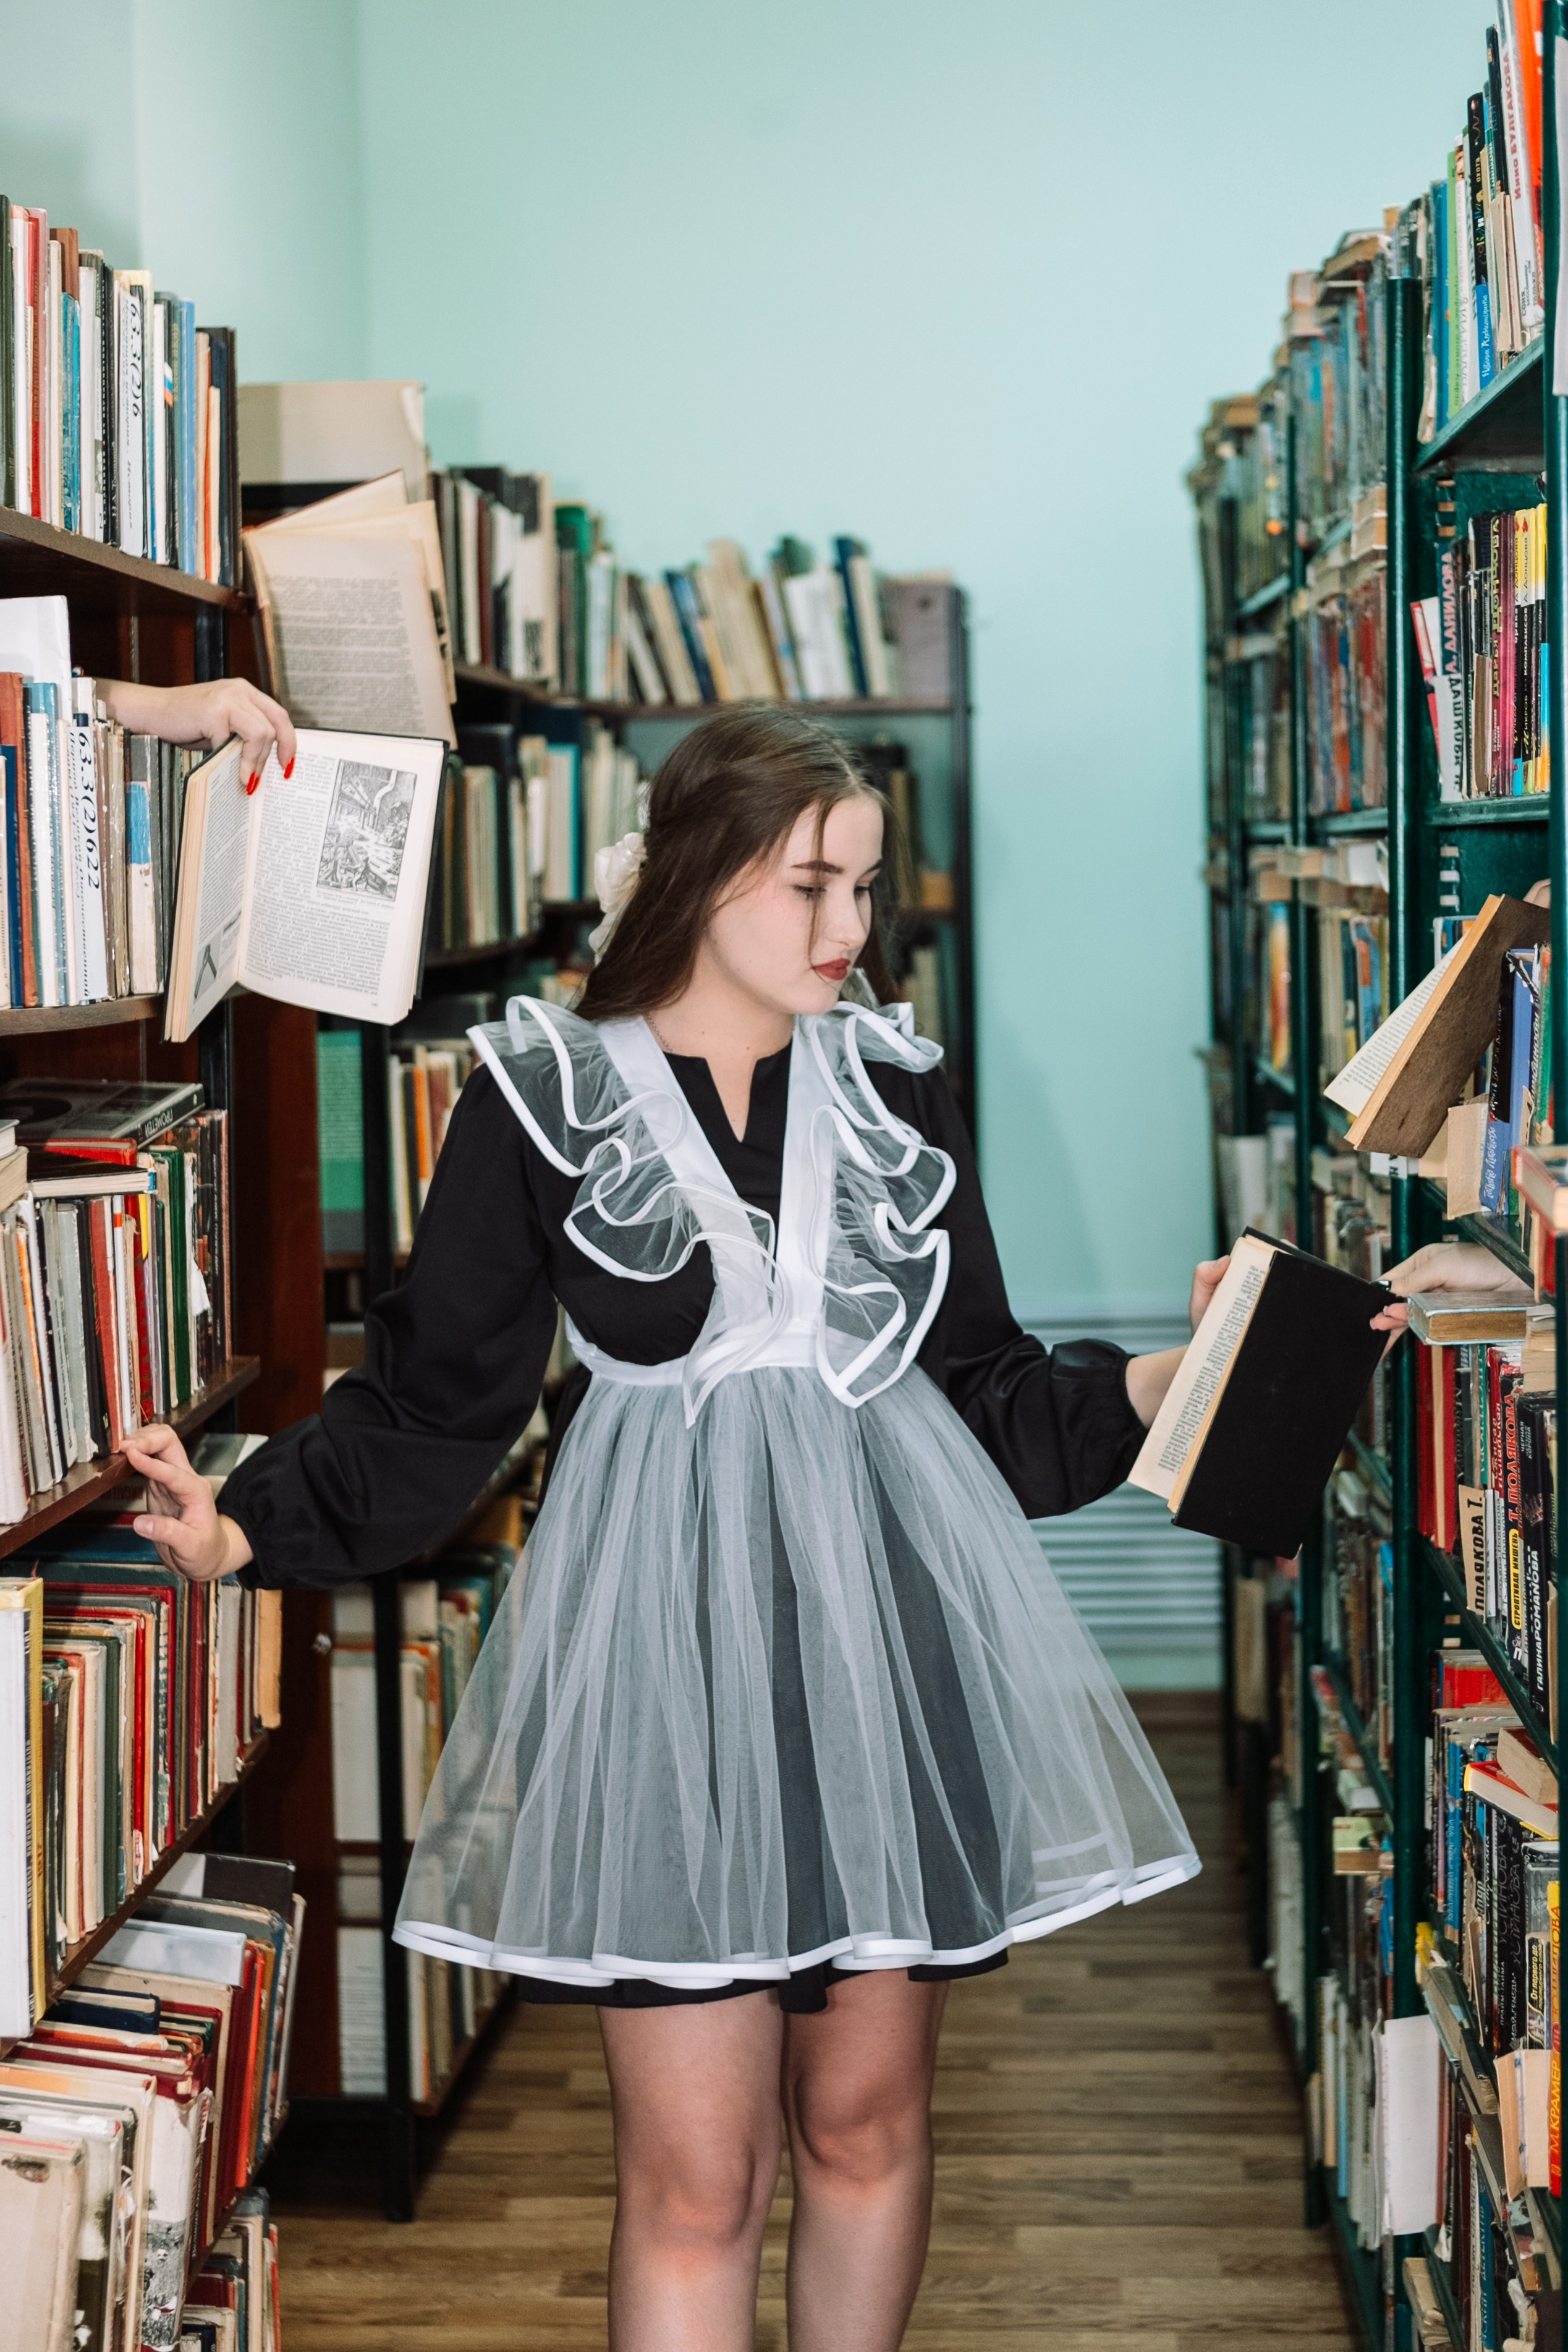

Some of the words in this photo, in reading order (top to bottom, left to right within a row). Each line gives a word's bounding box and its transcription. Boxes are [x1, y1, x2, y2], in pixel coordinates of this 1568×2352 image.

[1502, 52, 1517, 155] БУЛГАКОВА
[1513, 158, 1522, 200] Инна
[130, 303, 142, 417] 63.3(2)6
[1441, 551, 1457, 652] ДАНИЛОВА
[1490, 518, 1502, 633] ДОНЦОВА
[1445, 655, 1457, 673] А.
[1492, 639, 1500, 698] ДАРЬЯ
[78, 731, 100, 889] 63.3(2)622
[78, 866, 89, 998] Отечественной
[1504, 1393, 1518, 1503] ПОЛЯКОВА
[1467, 1496, 1483, 1508] Т.
[1507, 1506, 1519, 1522] Т.
[1471, 1515, 1484, 1610] ПОЛЯКОВА
[1511, 1532, 1519, 1570] МИШЕНЬ
[1498, 1844, 1507, 1943] УСТИНОВА
[1530, 1987, 1537, 2000] От
[1532, 1945, 1538, 1956] до
